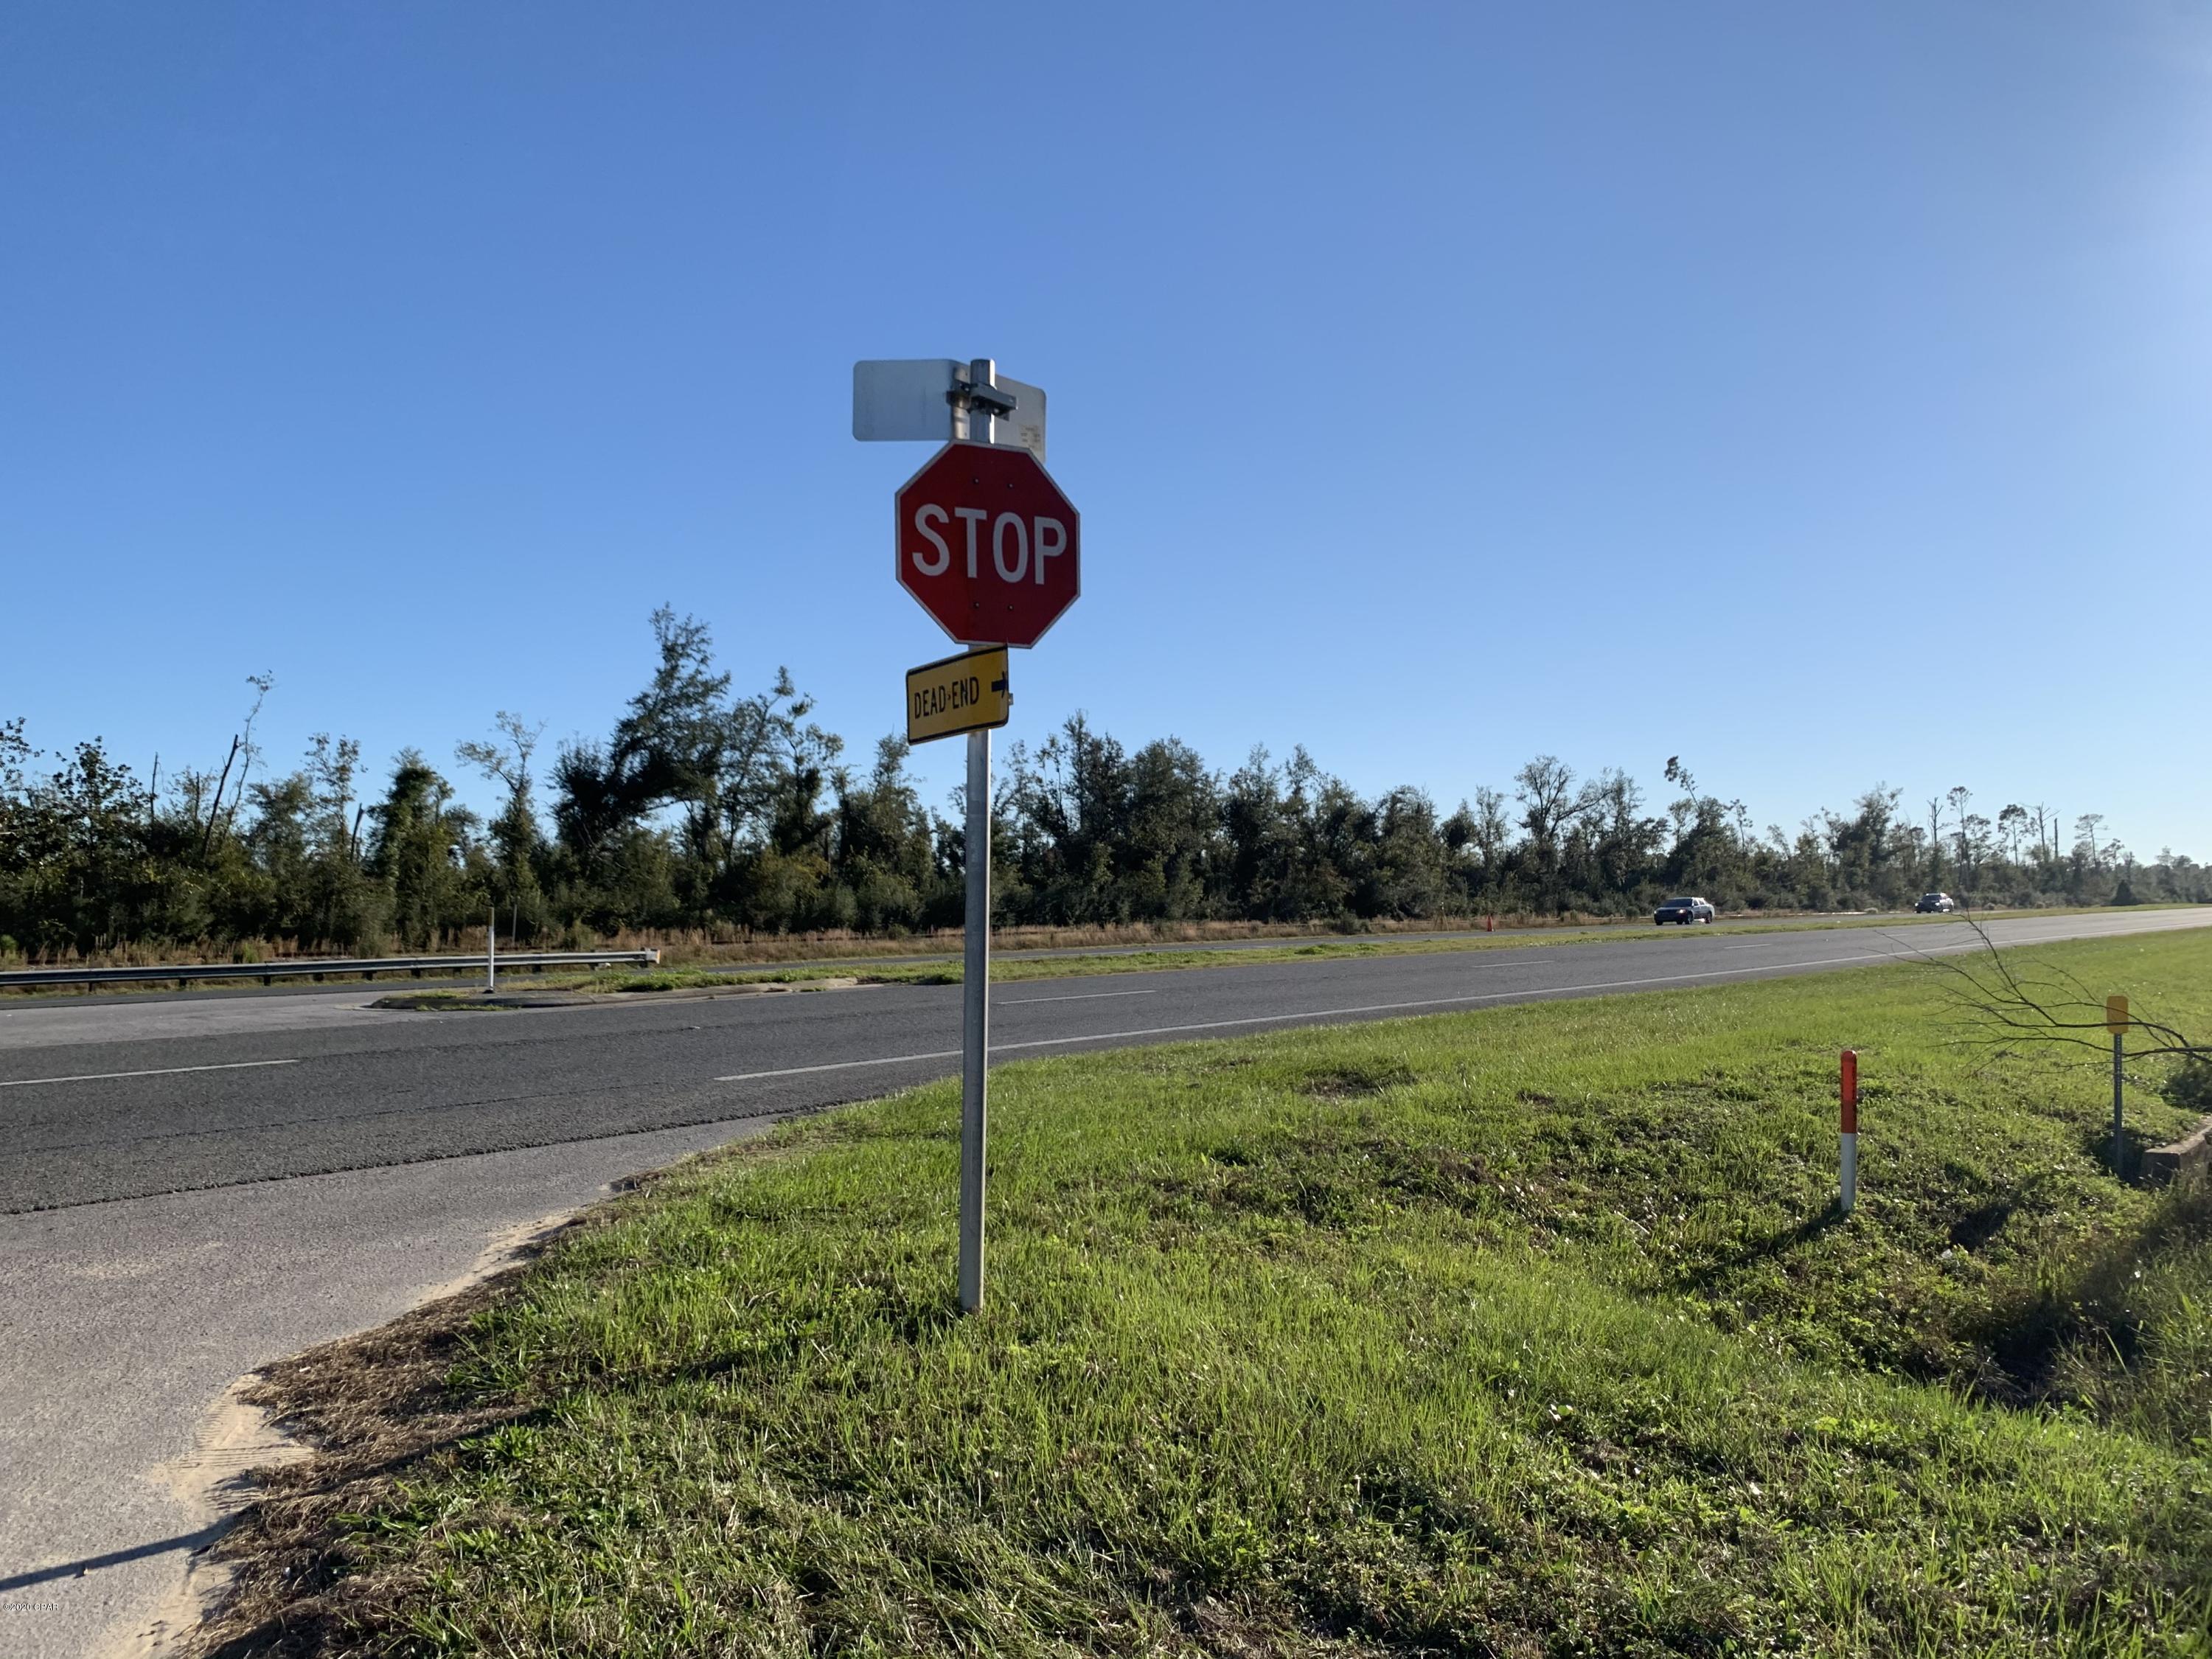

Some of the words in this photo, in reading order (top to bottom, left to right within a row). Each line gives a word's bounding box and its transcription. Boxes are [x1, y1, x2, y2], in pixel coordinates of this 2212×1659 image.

[912, 504, 1067, 585] STOP
[914, 685, 946, 719] DEAD
[952, 677, 979, 709] END
